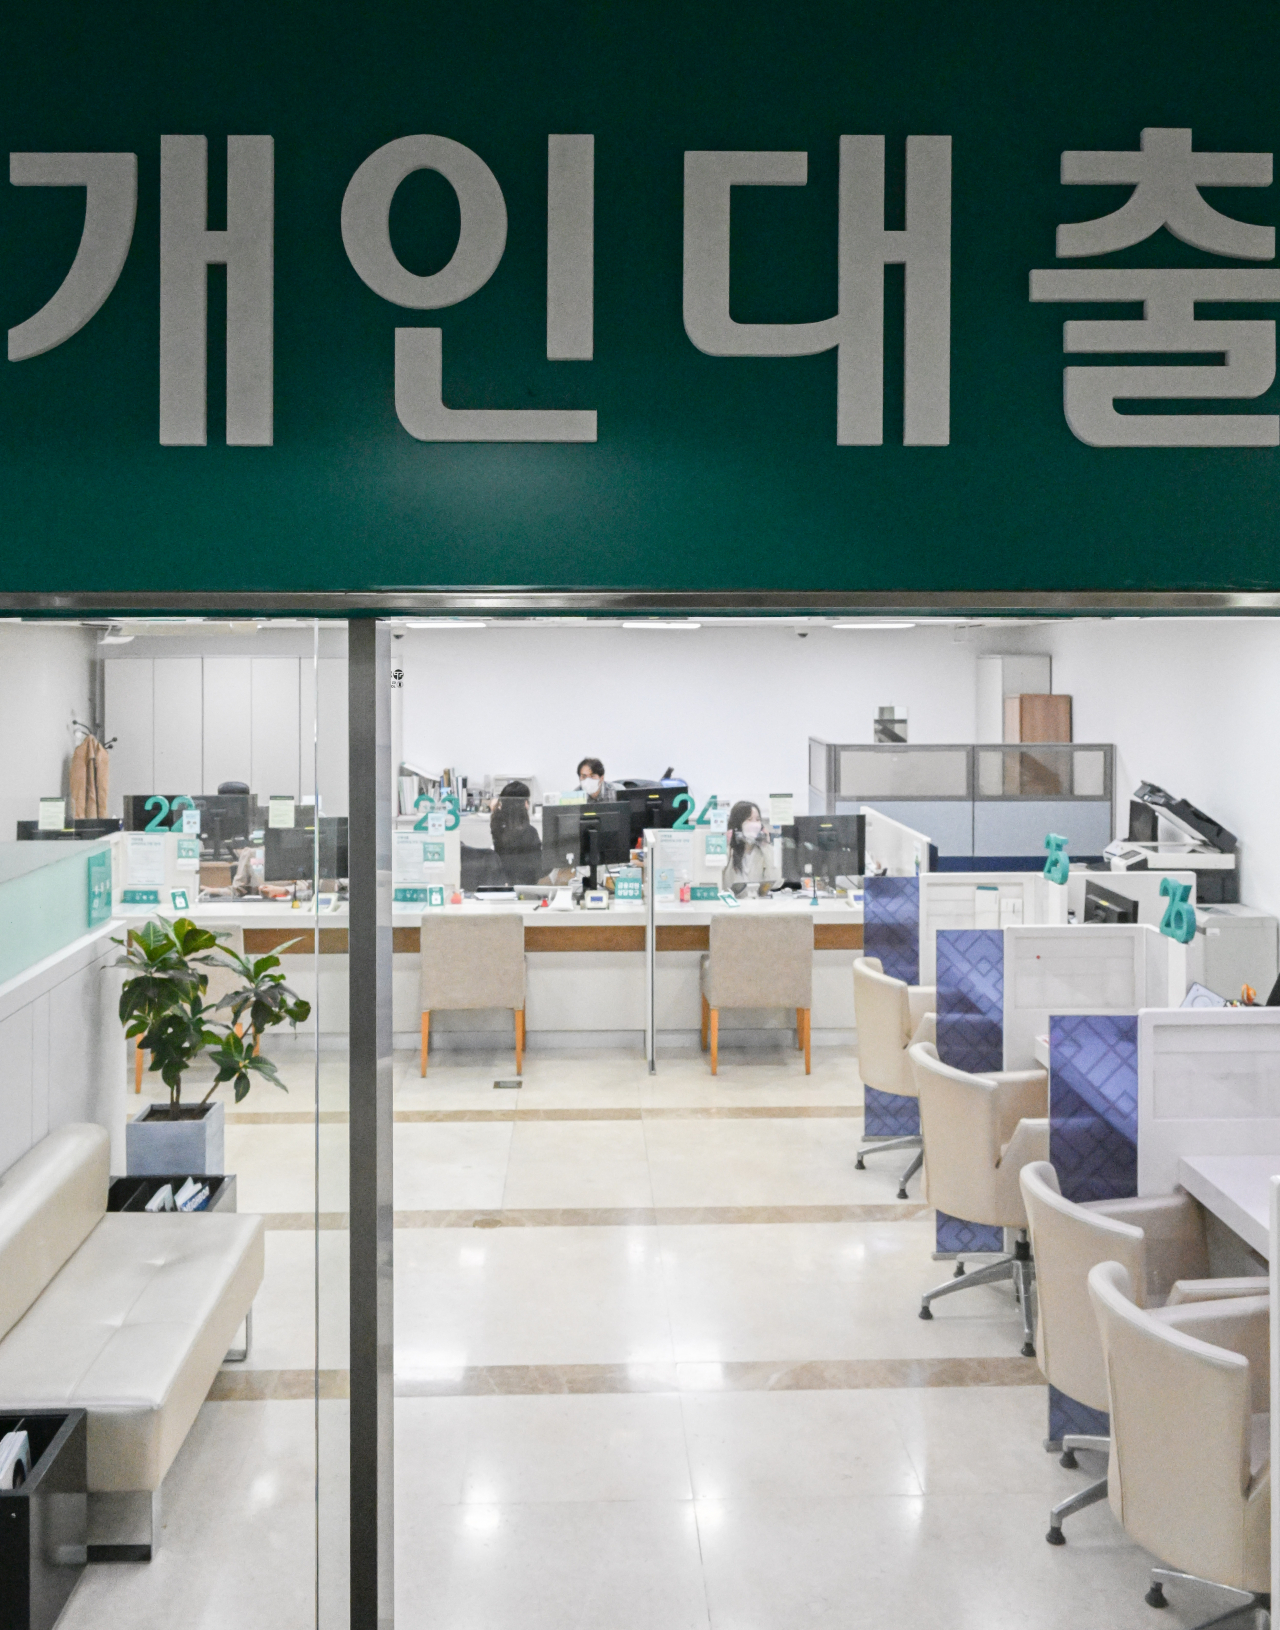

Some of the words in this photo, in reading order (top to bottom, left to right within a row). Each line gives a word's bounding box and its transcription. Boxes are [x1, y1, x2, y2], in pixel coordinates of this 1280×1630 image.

[7, 127, 1280, 447] 개인대출
[144, 795, 196, 833] 22
[413, 793, 461, 831] 23
[671, 792, 718, 830] 24
[1043, 832, 1070, 886] 25
[1158, 876, 1197, 944] 26
